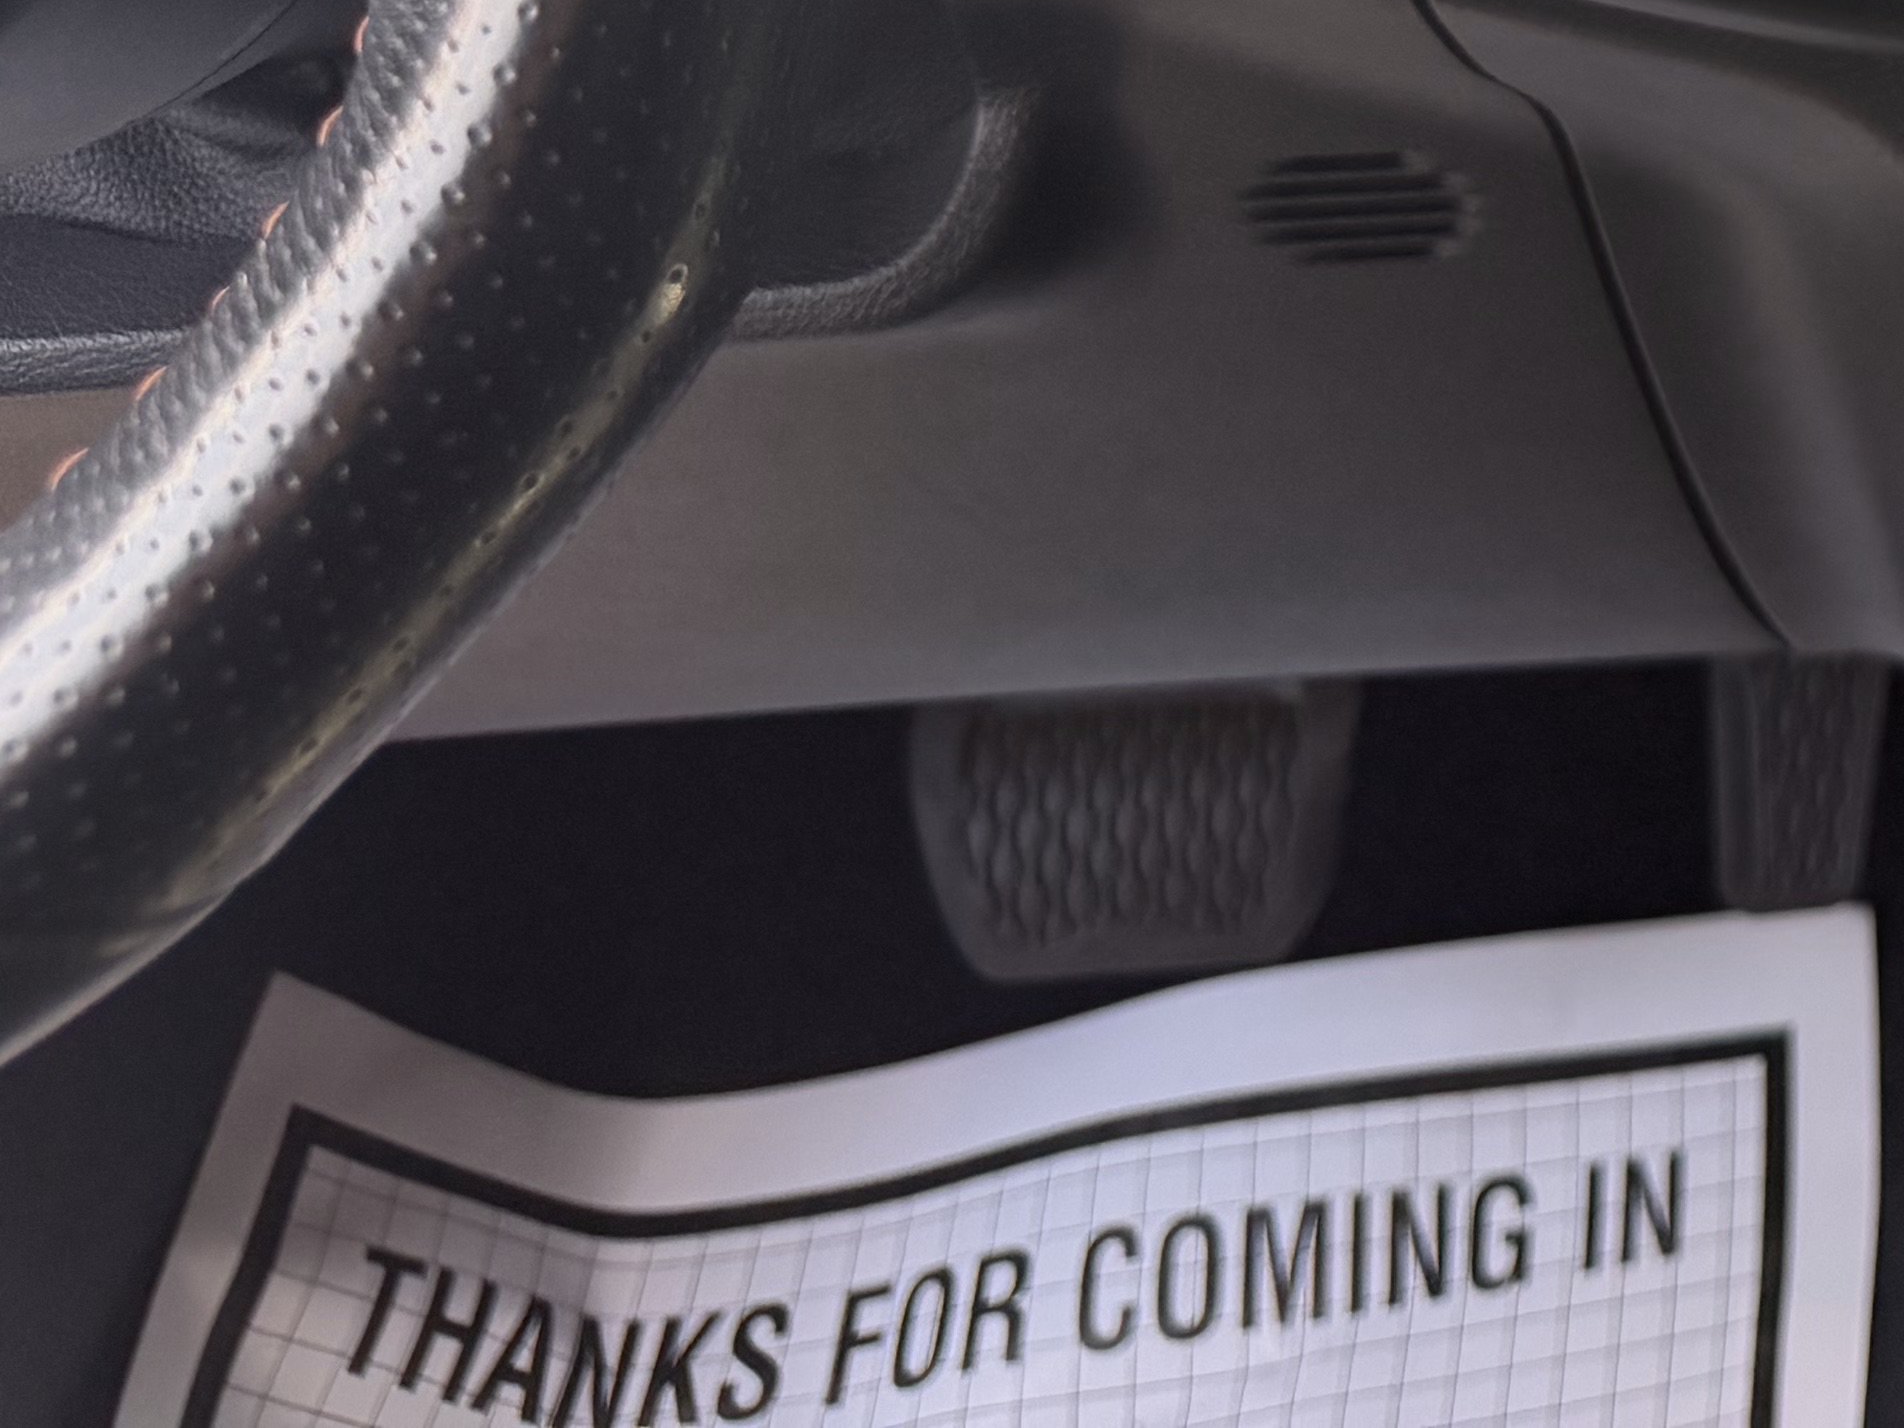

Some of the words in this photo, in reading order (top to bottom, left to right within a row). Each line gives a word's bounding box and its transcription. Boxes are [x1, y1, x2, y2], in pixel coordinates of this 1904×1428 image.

[347, 1245, 790, 1428] THANKS
[825, 1248, 1031, 1406] FOR
[1078, 1173, 1534, 1350] COMING
[1582, 1149, 1684, 1272] IN
